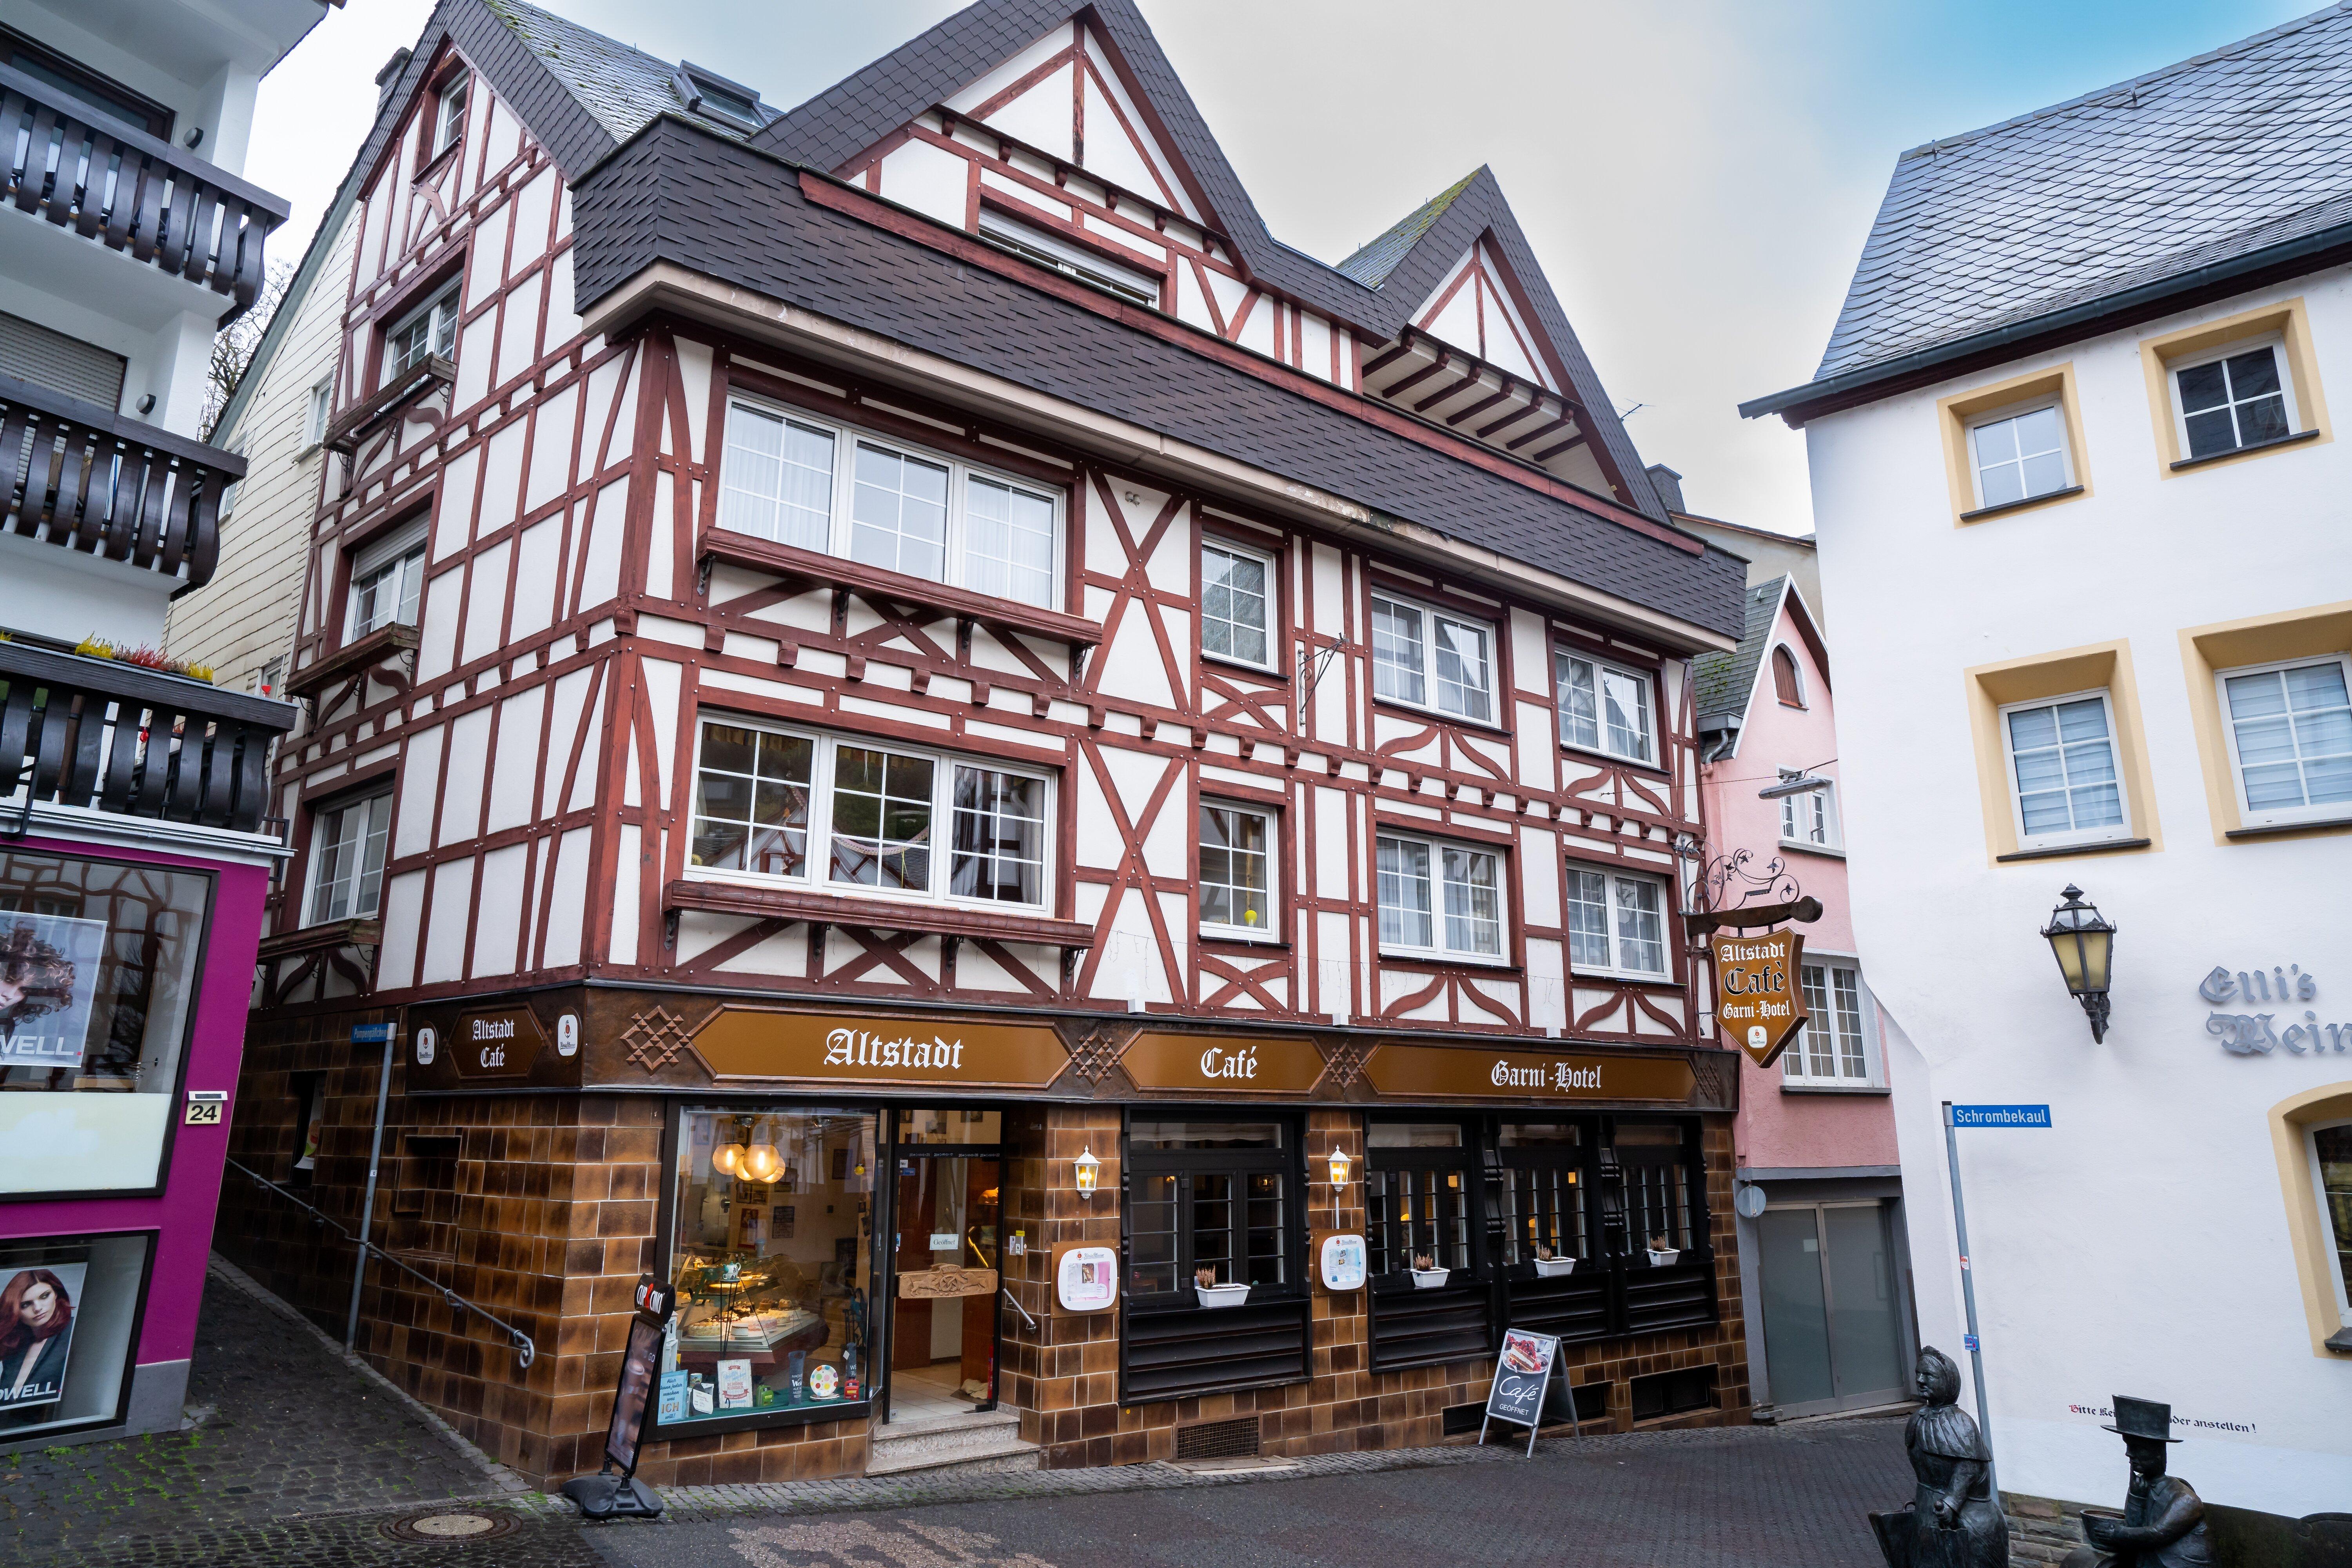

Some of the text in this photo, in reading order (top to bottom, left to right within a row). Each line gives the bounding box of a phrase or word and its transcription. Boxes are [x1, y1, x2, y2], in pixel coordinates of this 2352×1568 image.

[1720, 942, 1785, 963] Altstadt
[1724, 960, 1785, 996] Cafè
[2199, 963, 2316, 1002] Elli's
[472, 1018, 514, 1040] Altstadt
[481, 1043, 505, 1068] Café
[824, 1028, 964, 1069] Altstadt
[1200, 1046, 1258, 1079] Café
[190, 1105, 217, 1121] 24
[1956, 1109, 2046, 1123] Schrombekaul
[1499, 1376, 1539, 1404] Café
[661, 1402, 679, 1413] ICH
[1499, 1403, 1529, 1416] GEÖFFNET
[2069, 1405, 2096, 1415] Bitte
[2193, 1420, 2249, 1432] anstellen
